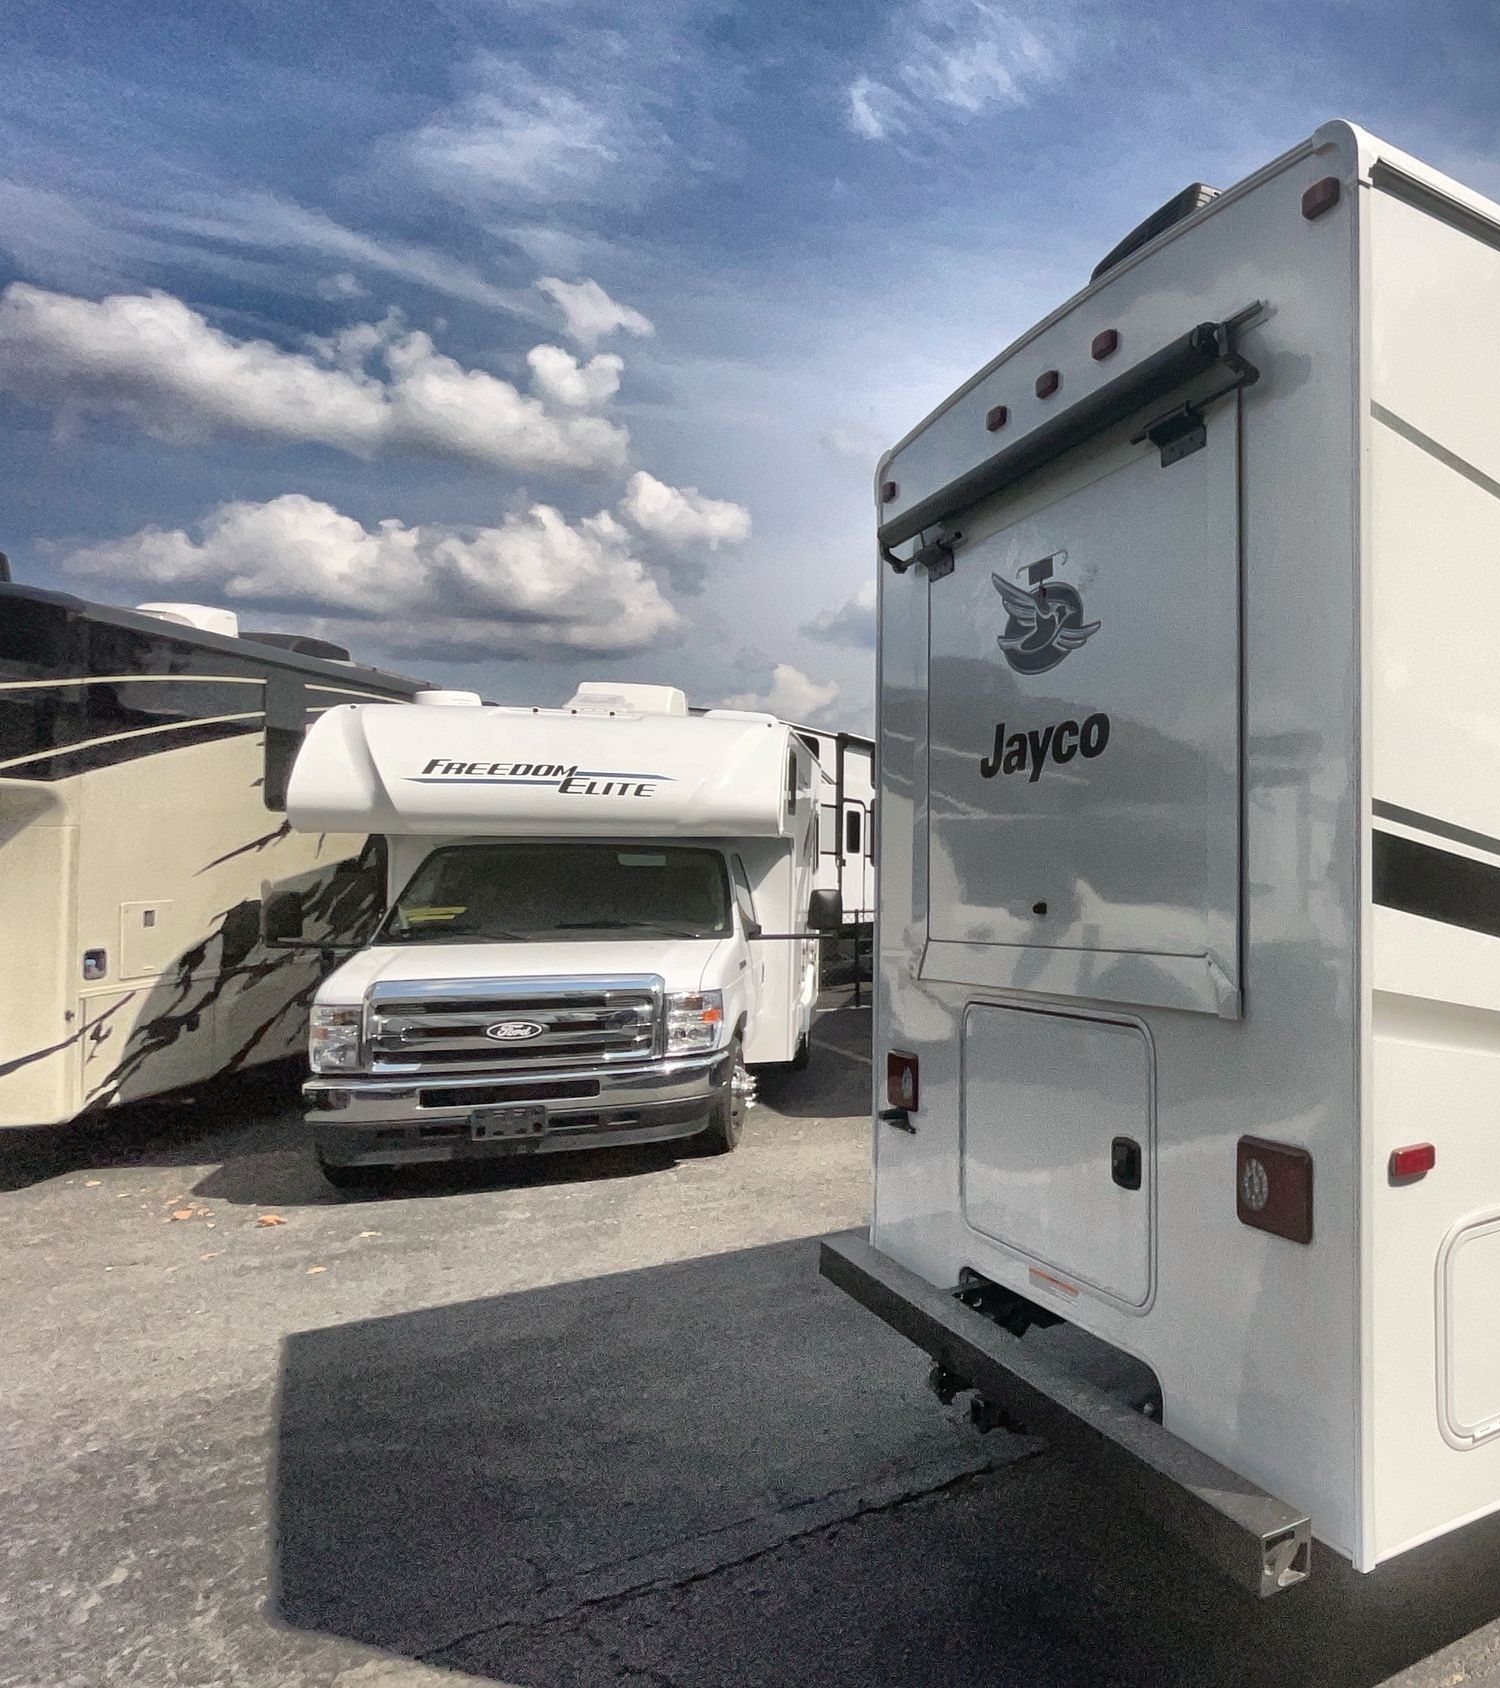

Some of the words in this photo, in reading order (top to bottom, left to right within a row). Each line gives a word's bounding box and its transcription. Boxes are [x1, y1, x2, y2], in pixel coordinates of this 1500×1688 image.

[980, 713, 1110, 783] Jayco
[421, 758, 578, 777] FREEDOM
[558, 777, 657, 798] ELITE
[497, 1025, 532, 1037] Ford
